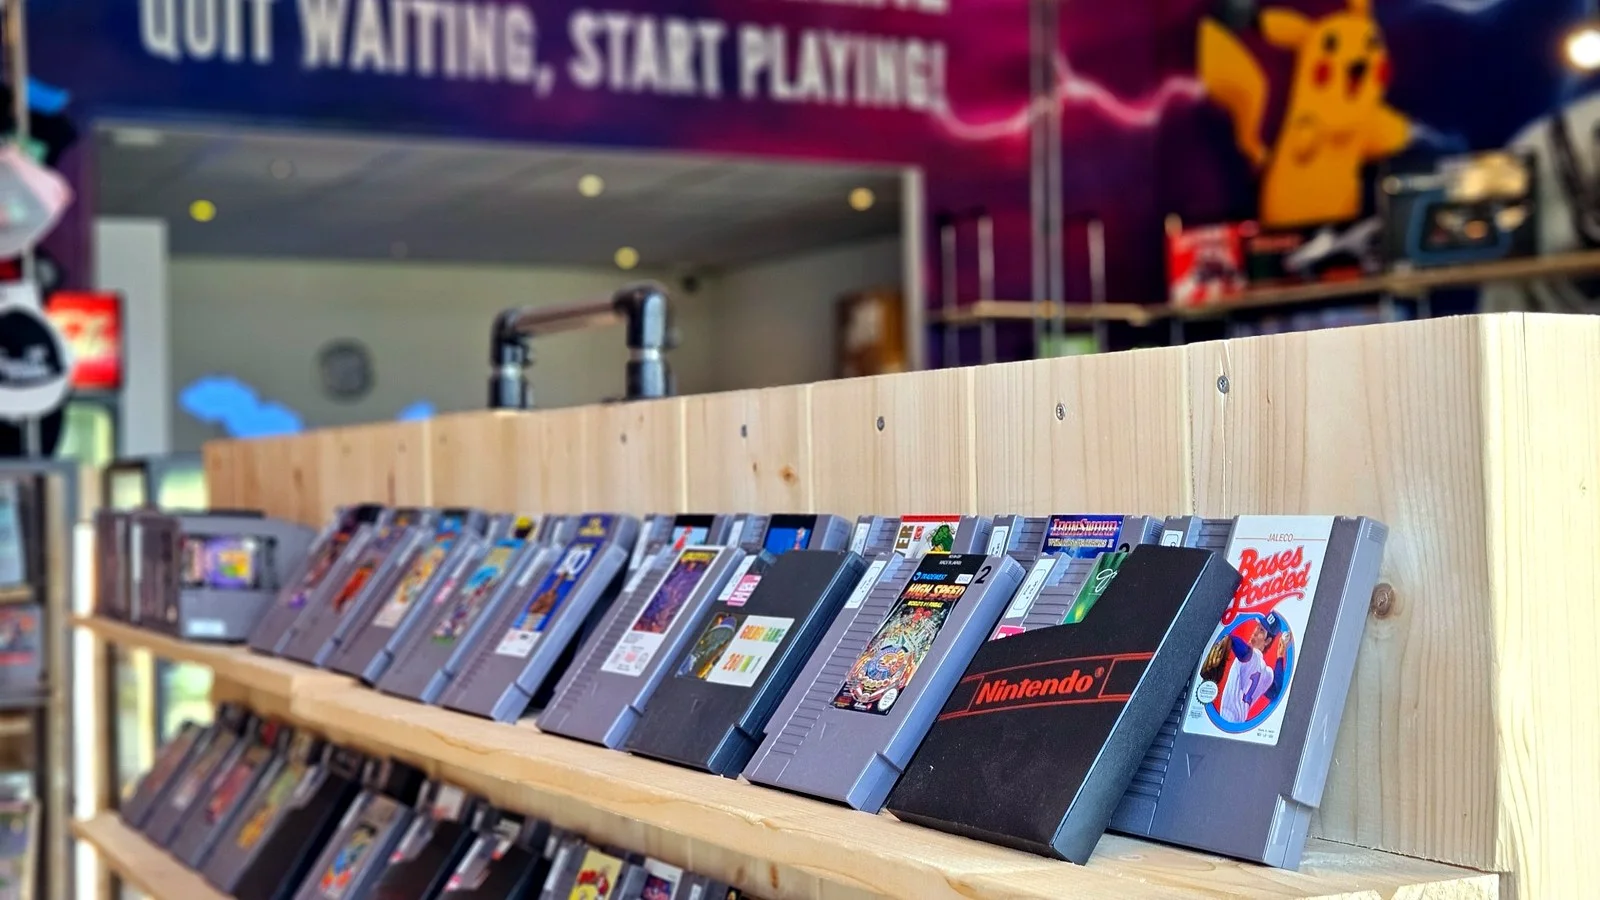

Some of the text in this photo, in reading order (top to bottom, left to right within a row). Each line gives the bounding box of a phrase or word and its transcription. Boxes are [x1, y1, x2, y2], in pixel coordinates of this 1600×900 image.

[140, 0, 949, 114] QUIT WAITING, START PLAYING!
[1267, 533, 1294, 542] JALECO
[974, 565, 992, 584] 2
[1238, 544, 1304, 582] Bases
[907, 583, 966, 600] HIGH SPEED
[975, 669, 1094, 705] Nintendo
